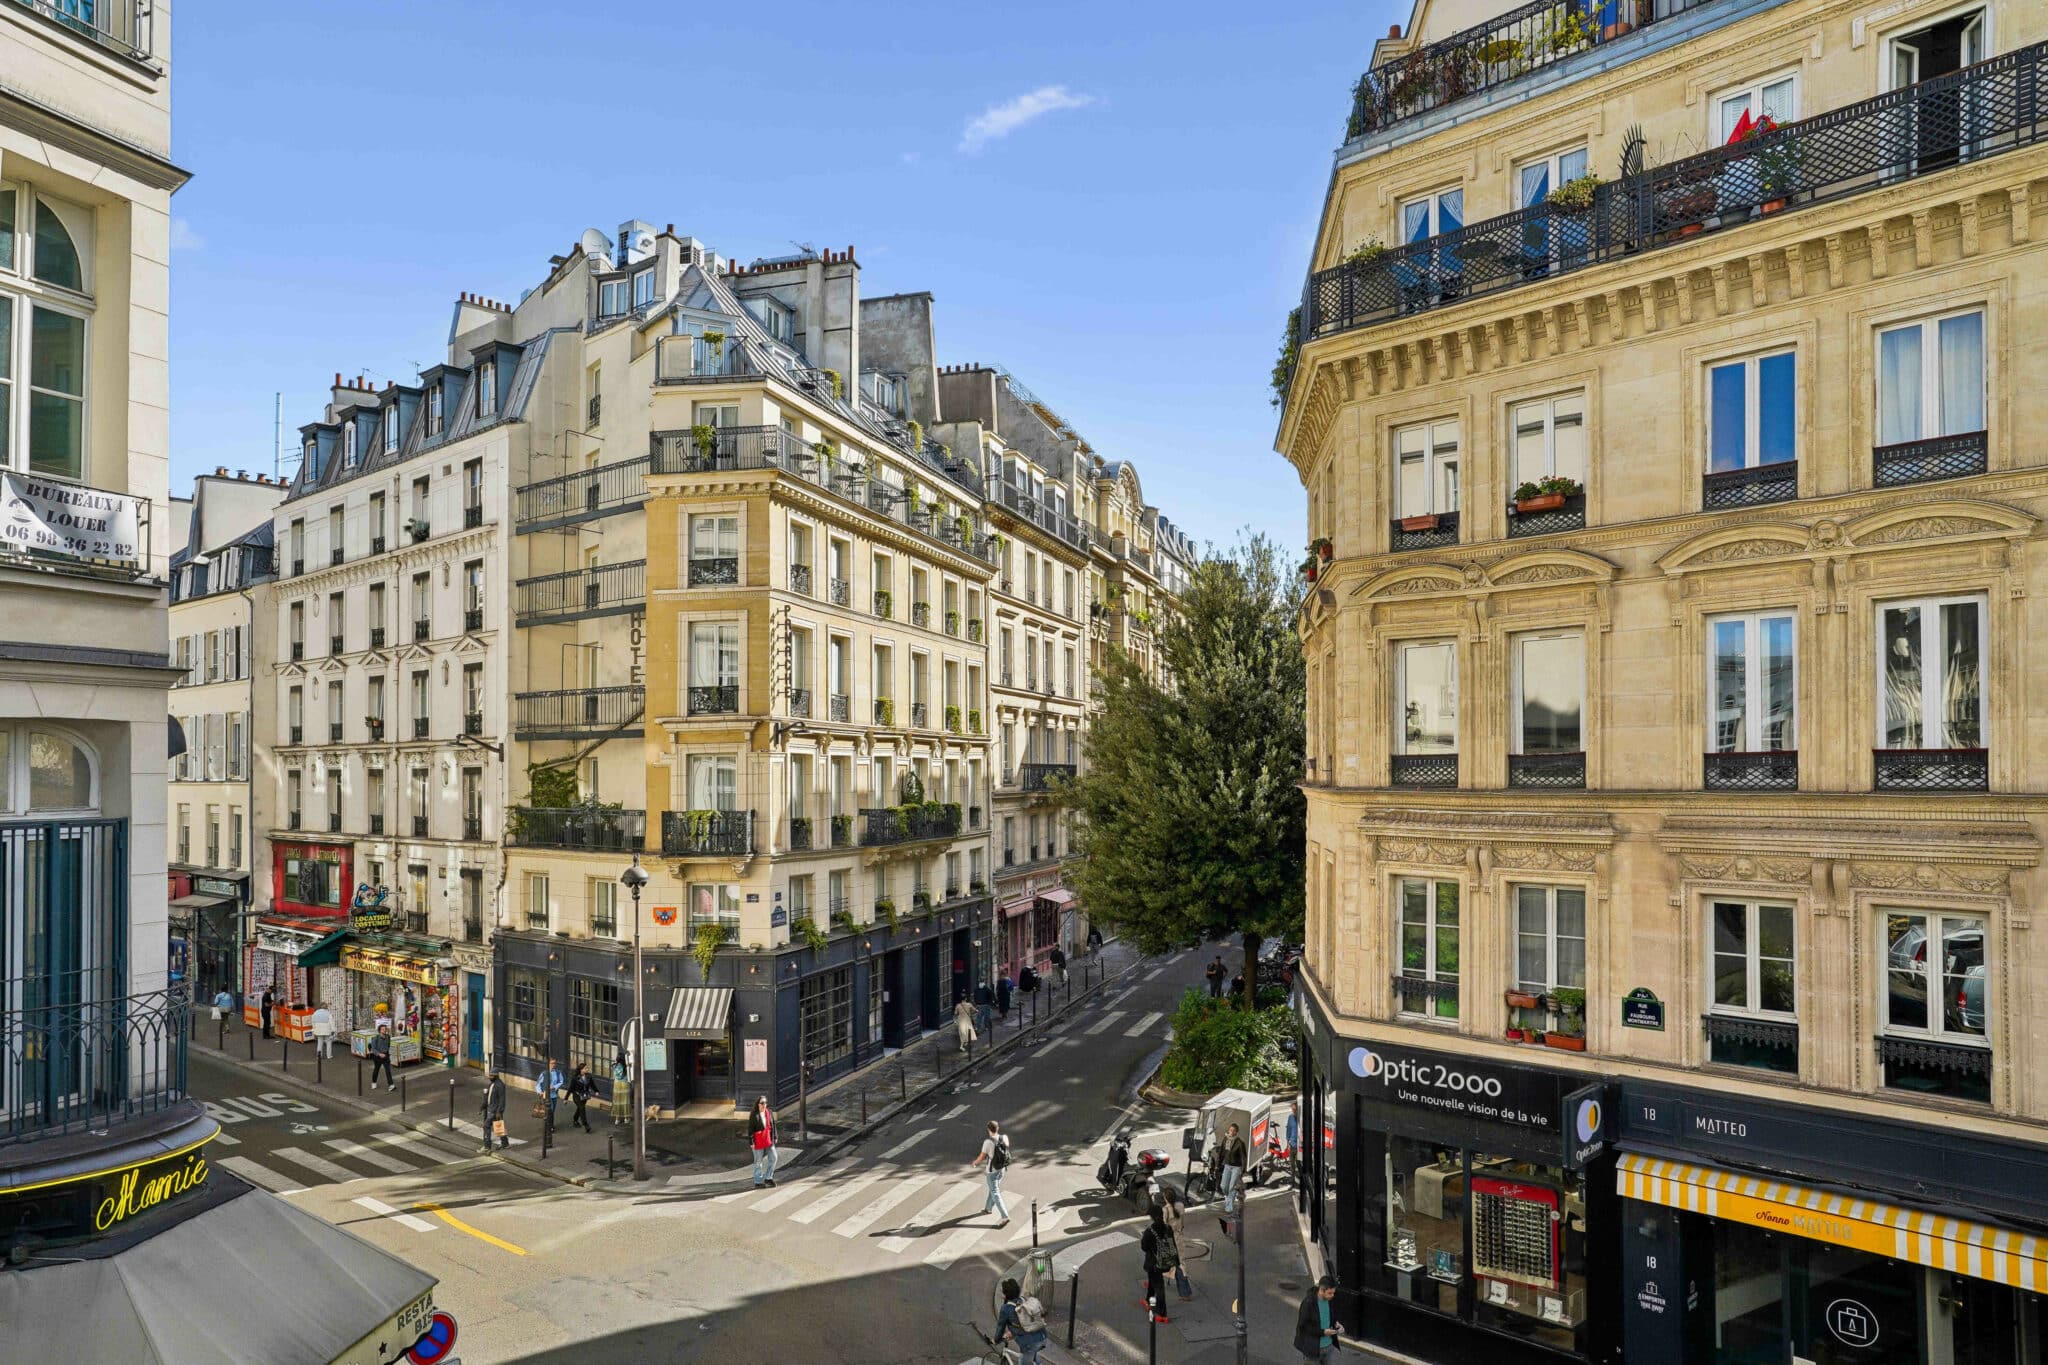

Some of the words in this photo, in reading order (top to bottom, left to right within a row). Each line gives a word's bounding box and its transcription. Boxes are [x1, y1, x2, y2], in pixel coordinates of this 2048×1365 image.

[26, 483, 113, 511] BUREAUX
[46, 510, 107, 532] LOUER
[6, 524, 29, 541] 06
[64, 536, 87, 552] 36
[94, 541, 109, 554] 22
[115, 543, 132, 556] 82
[630, 609, 642, 703] HOTEL
[784, 604, 792, 698] PANACHE
[355, 914, 390, 922] LOCATION
[353, 960, 380, 973] LOCATION
[382, 966, 390, 975] DE
[390, 968, 423, 980] COSTUMES
[1627, 1018, 1659, 1026] MONTMARTRE
[1630, 1013, 1656, 1021] FAUBOURG
[202, 1093, 320, 1124] BUS
[1398, 1089, 1418, 1102] Une
[1421, 1096, 1465, 1110] nouvelle
[1467, 1101, 1498, 1117] vision
[1501, 1107, 1515, 1120] de
[1518, 1110, 1528, 1122] la
[1531, 1112, 1548, 1126] vie
[1643, 1107, 1656, 1121] 18
[1696, 1115, 1747, 1137] MATTEO
[96, 1155, 209, 1230] Mamie
[1756, 1210, 1790, 1226] Nonno
[1793, 1214, 1853, 1240] MATTEO
[1646, 1255, 1657, 1269] 18
